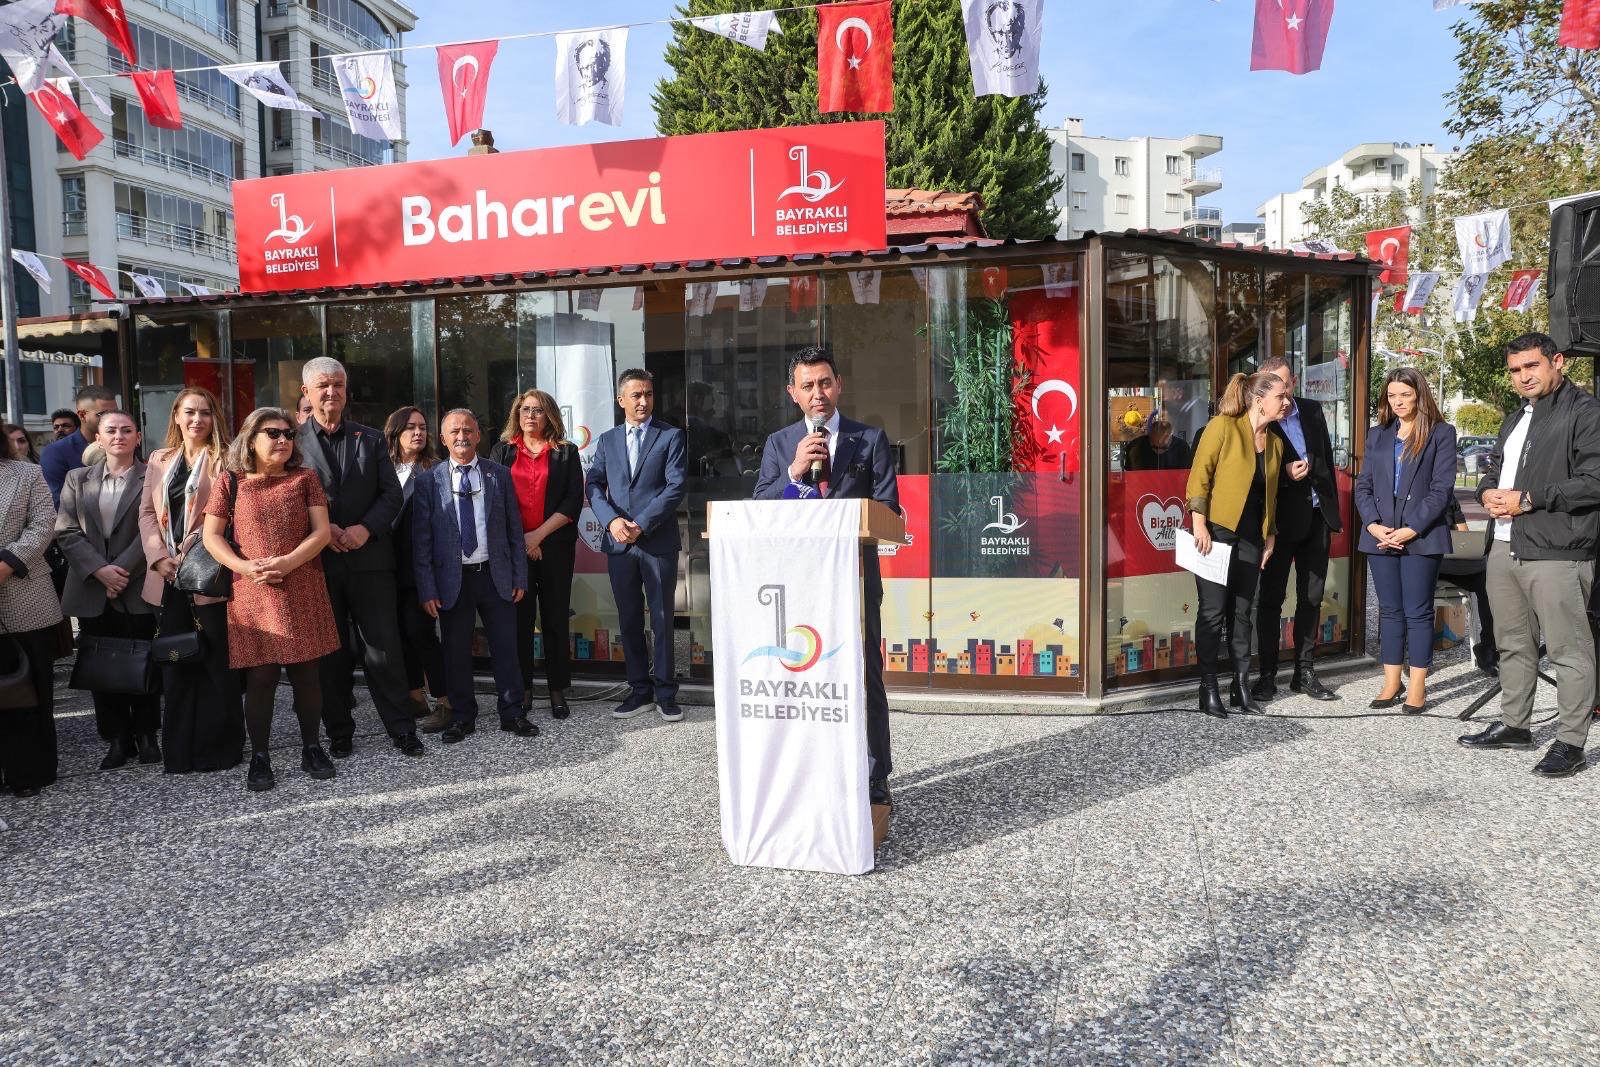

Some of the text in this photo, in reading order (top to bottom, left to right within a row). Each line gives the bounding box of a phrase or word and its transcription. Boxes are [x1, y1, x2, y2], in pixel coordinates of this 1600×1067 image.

[348, 110, 391, 122] ELEDİYESİ
[401, 171, 666, 246] Baharevi
[776, 205, 848, 221] BAYRAKLI
[776, 219, 849, 236] BELEDİYESİ
[264, 246, 318, 261] BAYRAKLI
[265, 258, 319, 274] BELEDİYESİ
[1151, 515, 1181, 529] Biz Bir
[981, 537, 1030, 546] BAYRAKLI
[981, 546, 1030, 556] BELEDİYESİ
[739, 679, 849, 701] BAYRAKLI
[740, 702, 849, 723] BELEDİYESİ
